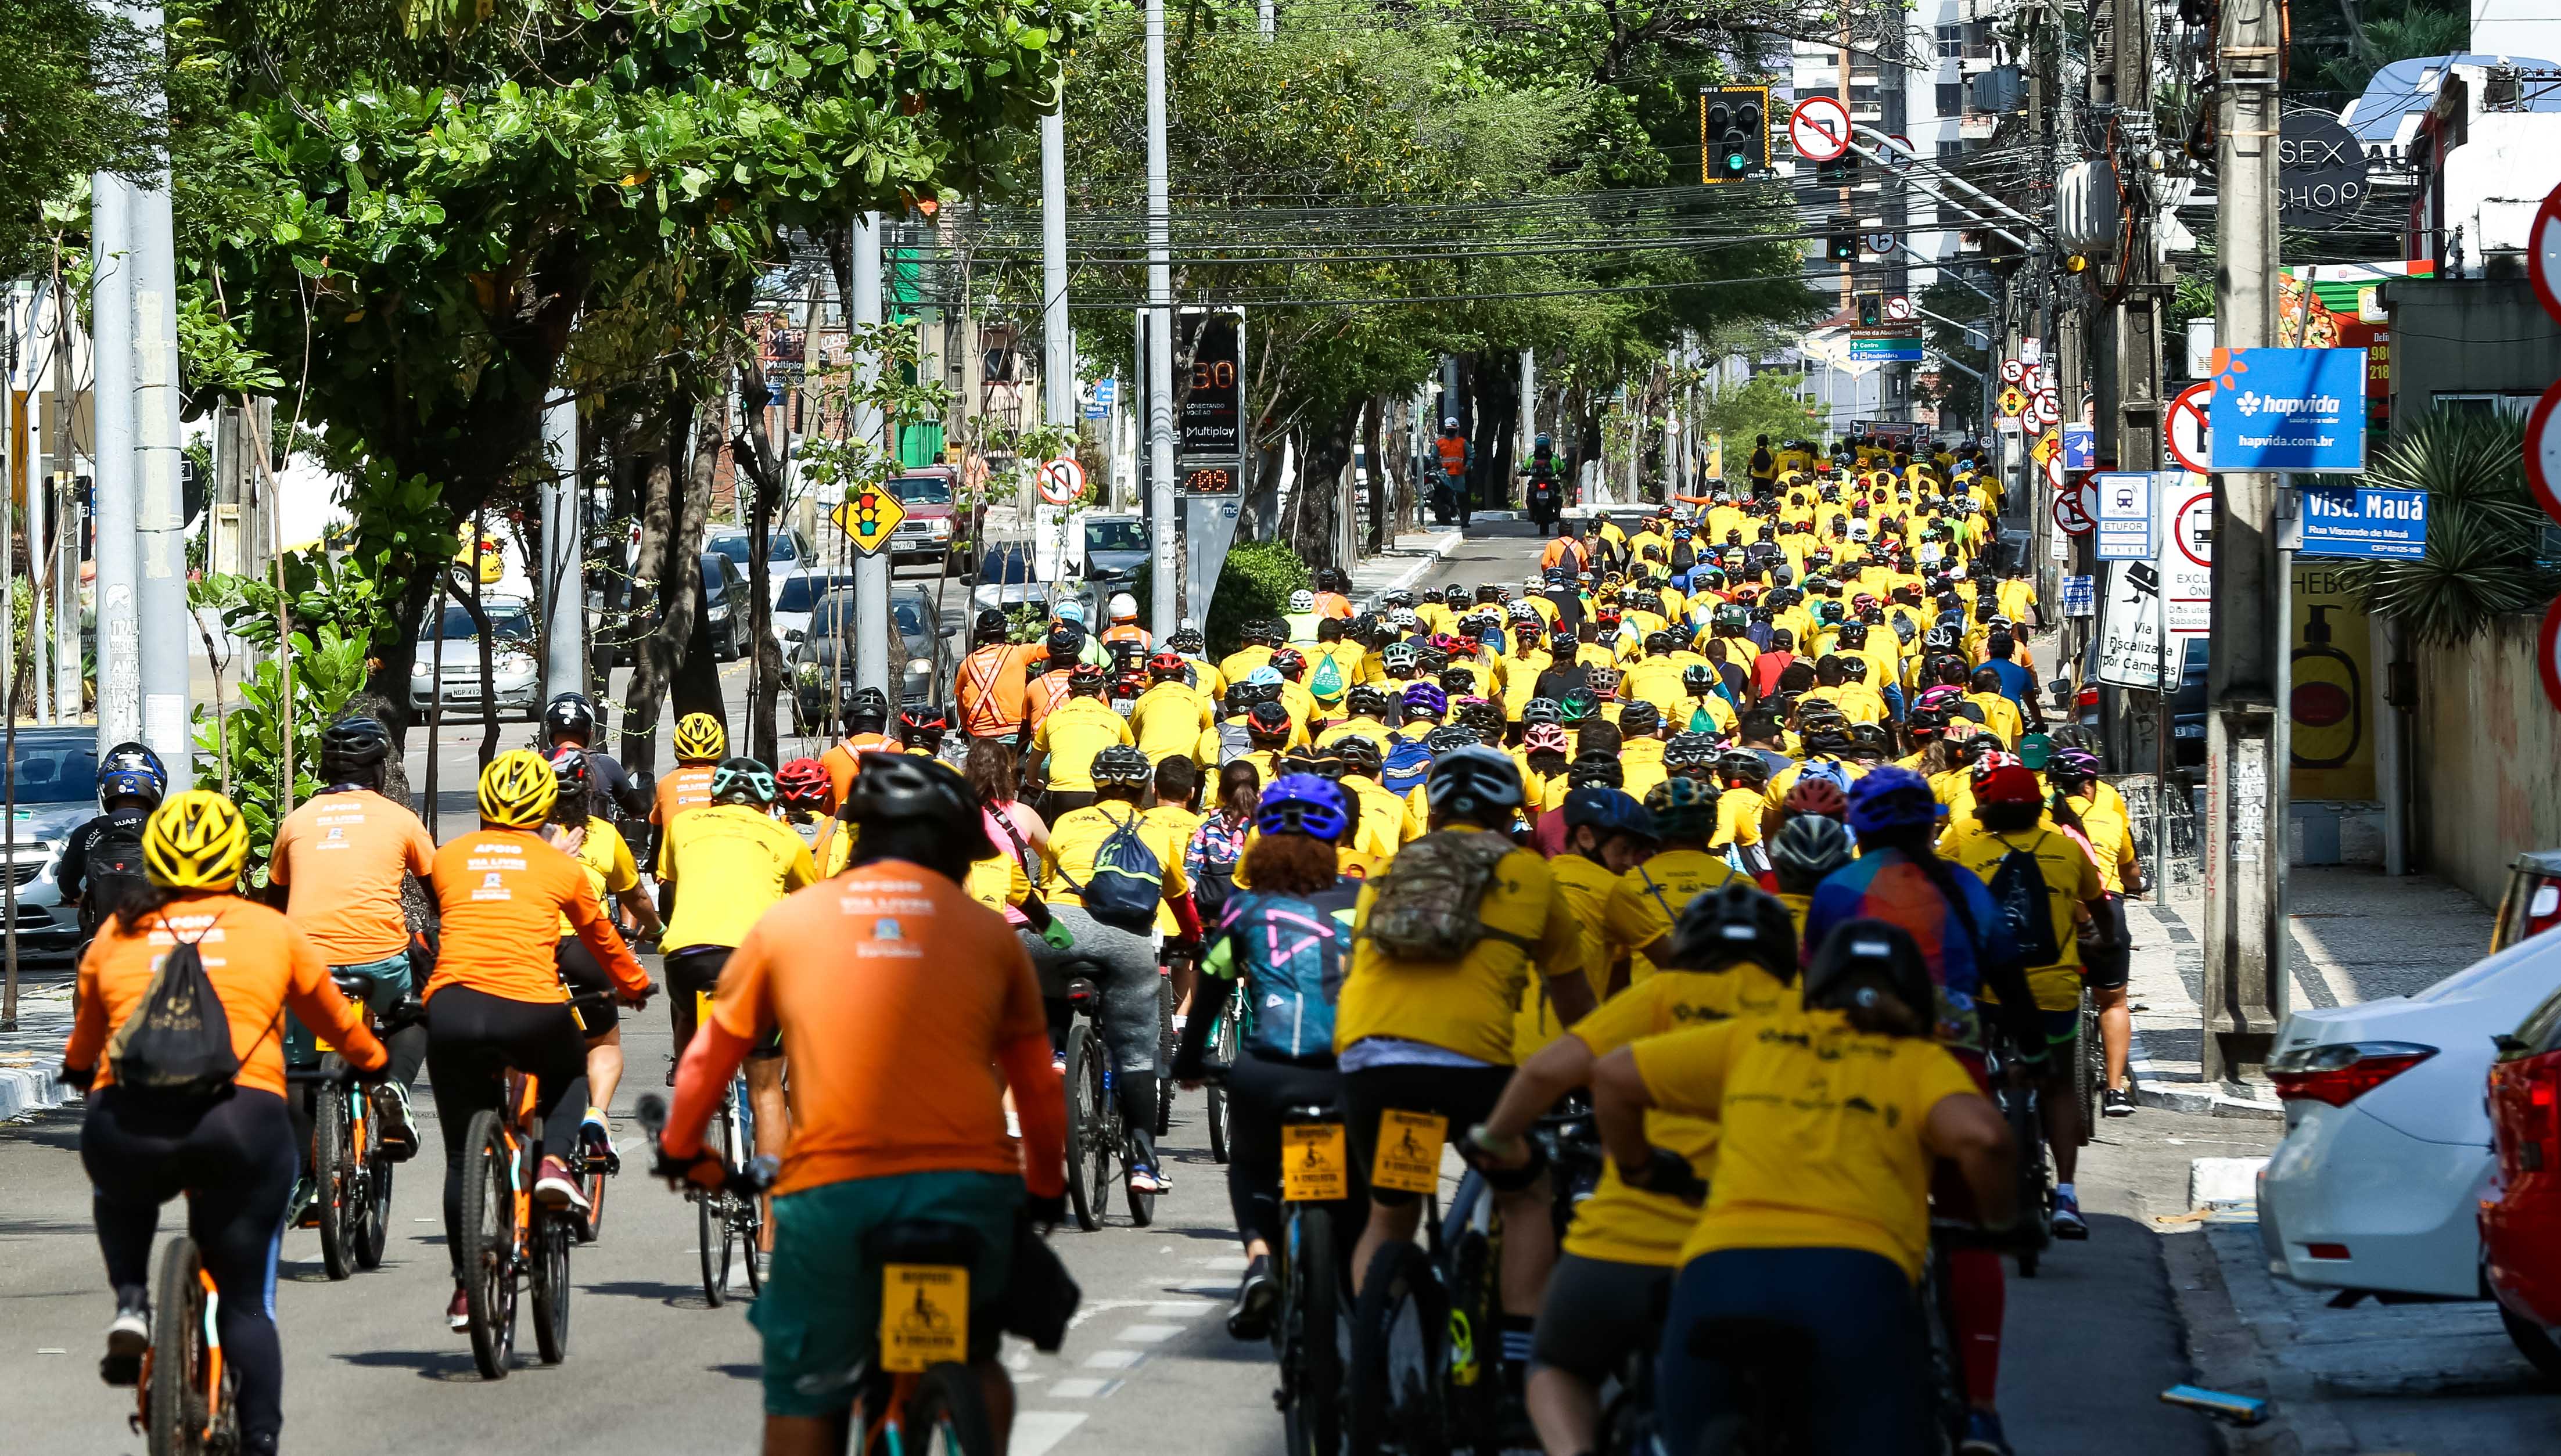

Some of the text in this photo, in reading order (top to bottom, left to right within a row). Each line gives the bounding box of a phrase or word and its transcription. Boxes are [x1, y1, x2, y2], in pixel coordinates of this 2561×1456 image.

[2279, 140, 2345, 163] SEX
[2263, 394, 2340, 416] hapvida
[1186, 426, 1235, 437] Multiplay
[1982, 437, 1991, 445] 50
[2239, 434, 2335, 449] hapvida.com.br
[2309, 491, 2423, 521] Visc. Mauá
[2308, 525, 2409, 538] Rua Visconde de Mauá
[2134, 621, 2152, 634] Via
[2170, 617, 2208, 625] Sábados
[2103, 656, 2176, 676] por Câmeas
[322, 804, 362, 812] APOIO
[473, 844, 522, 854] APOIO
